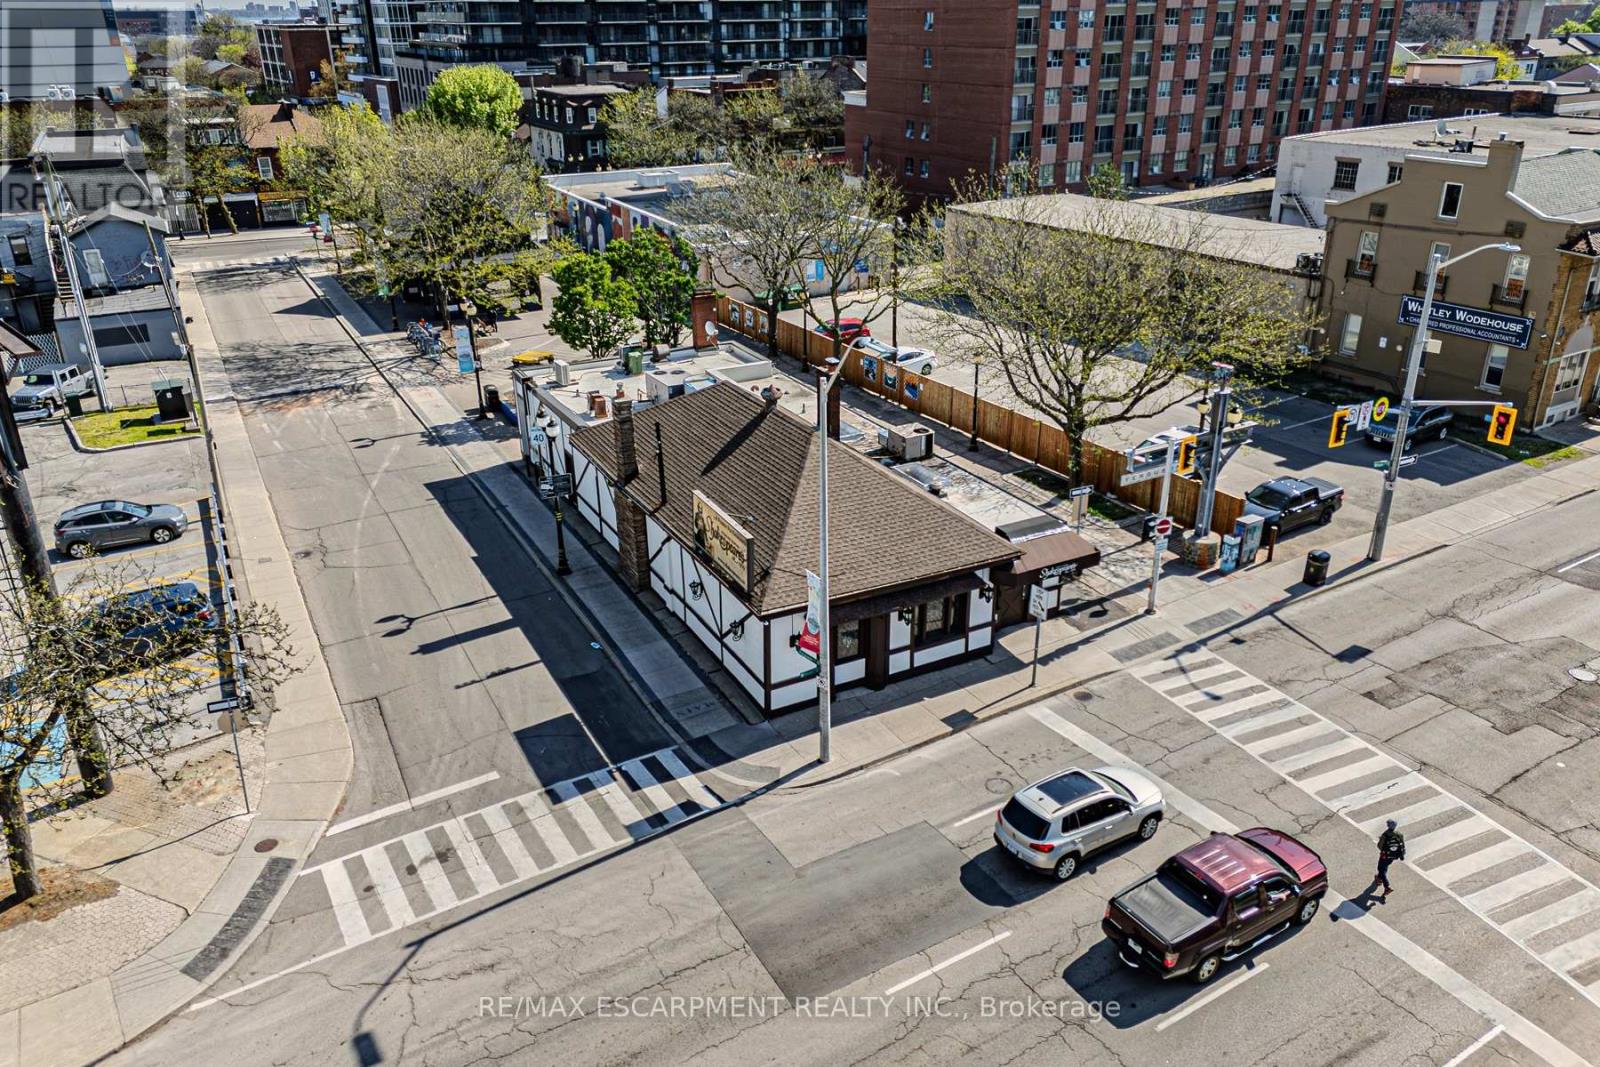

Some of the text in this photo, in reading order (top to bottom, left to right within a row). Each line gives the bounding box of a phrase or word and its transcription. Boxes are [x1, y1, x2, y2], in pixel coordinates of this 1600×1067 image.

[1408, 300, 1524, 333] WHTLEY WODEHOUSE
[1439, 322, 1476, 335] PROFESSIONAL
[1477, 330, 1516, 343] ACCOUNTANTS
[533, 434, 545, 442] 40
